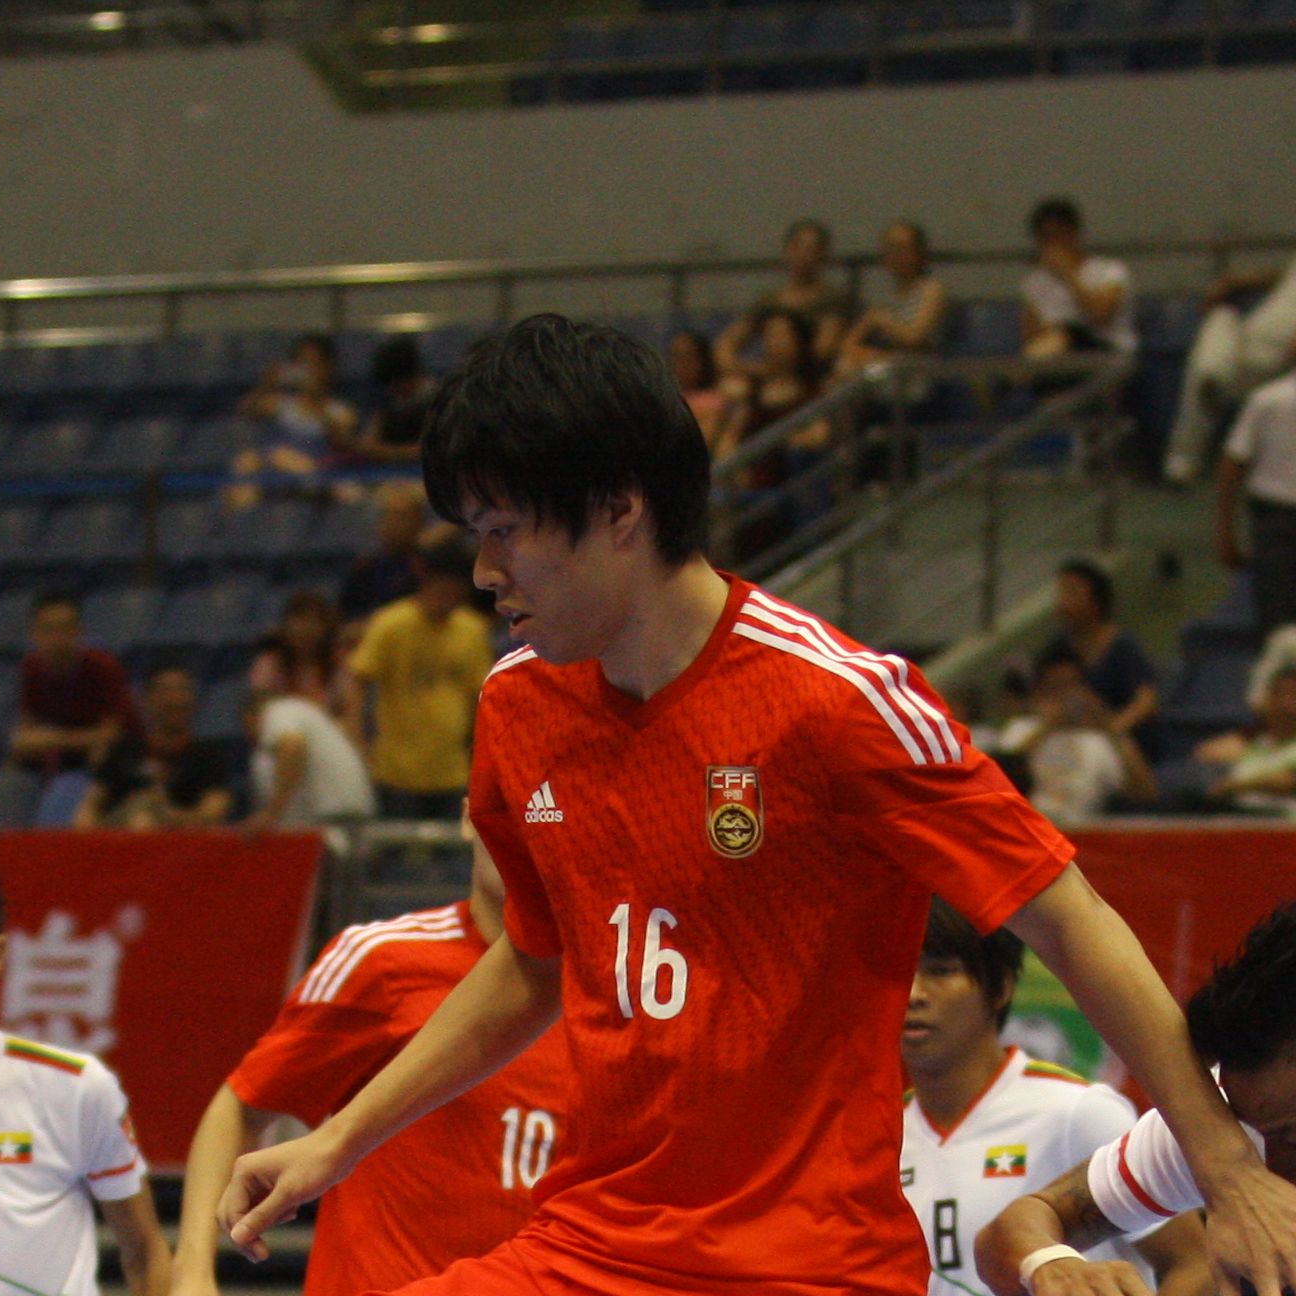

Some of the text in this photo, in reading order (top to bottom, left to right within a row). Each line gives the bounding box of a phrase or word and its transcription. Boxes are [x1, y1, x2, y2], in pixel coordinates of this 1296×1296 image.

[525, 808, 564, 823] adidas
[609, 903, 688, 1020] 16
[500, 1107, 555, 1190] 10
[932, 1198, 962, 1270] 8
